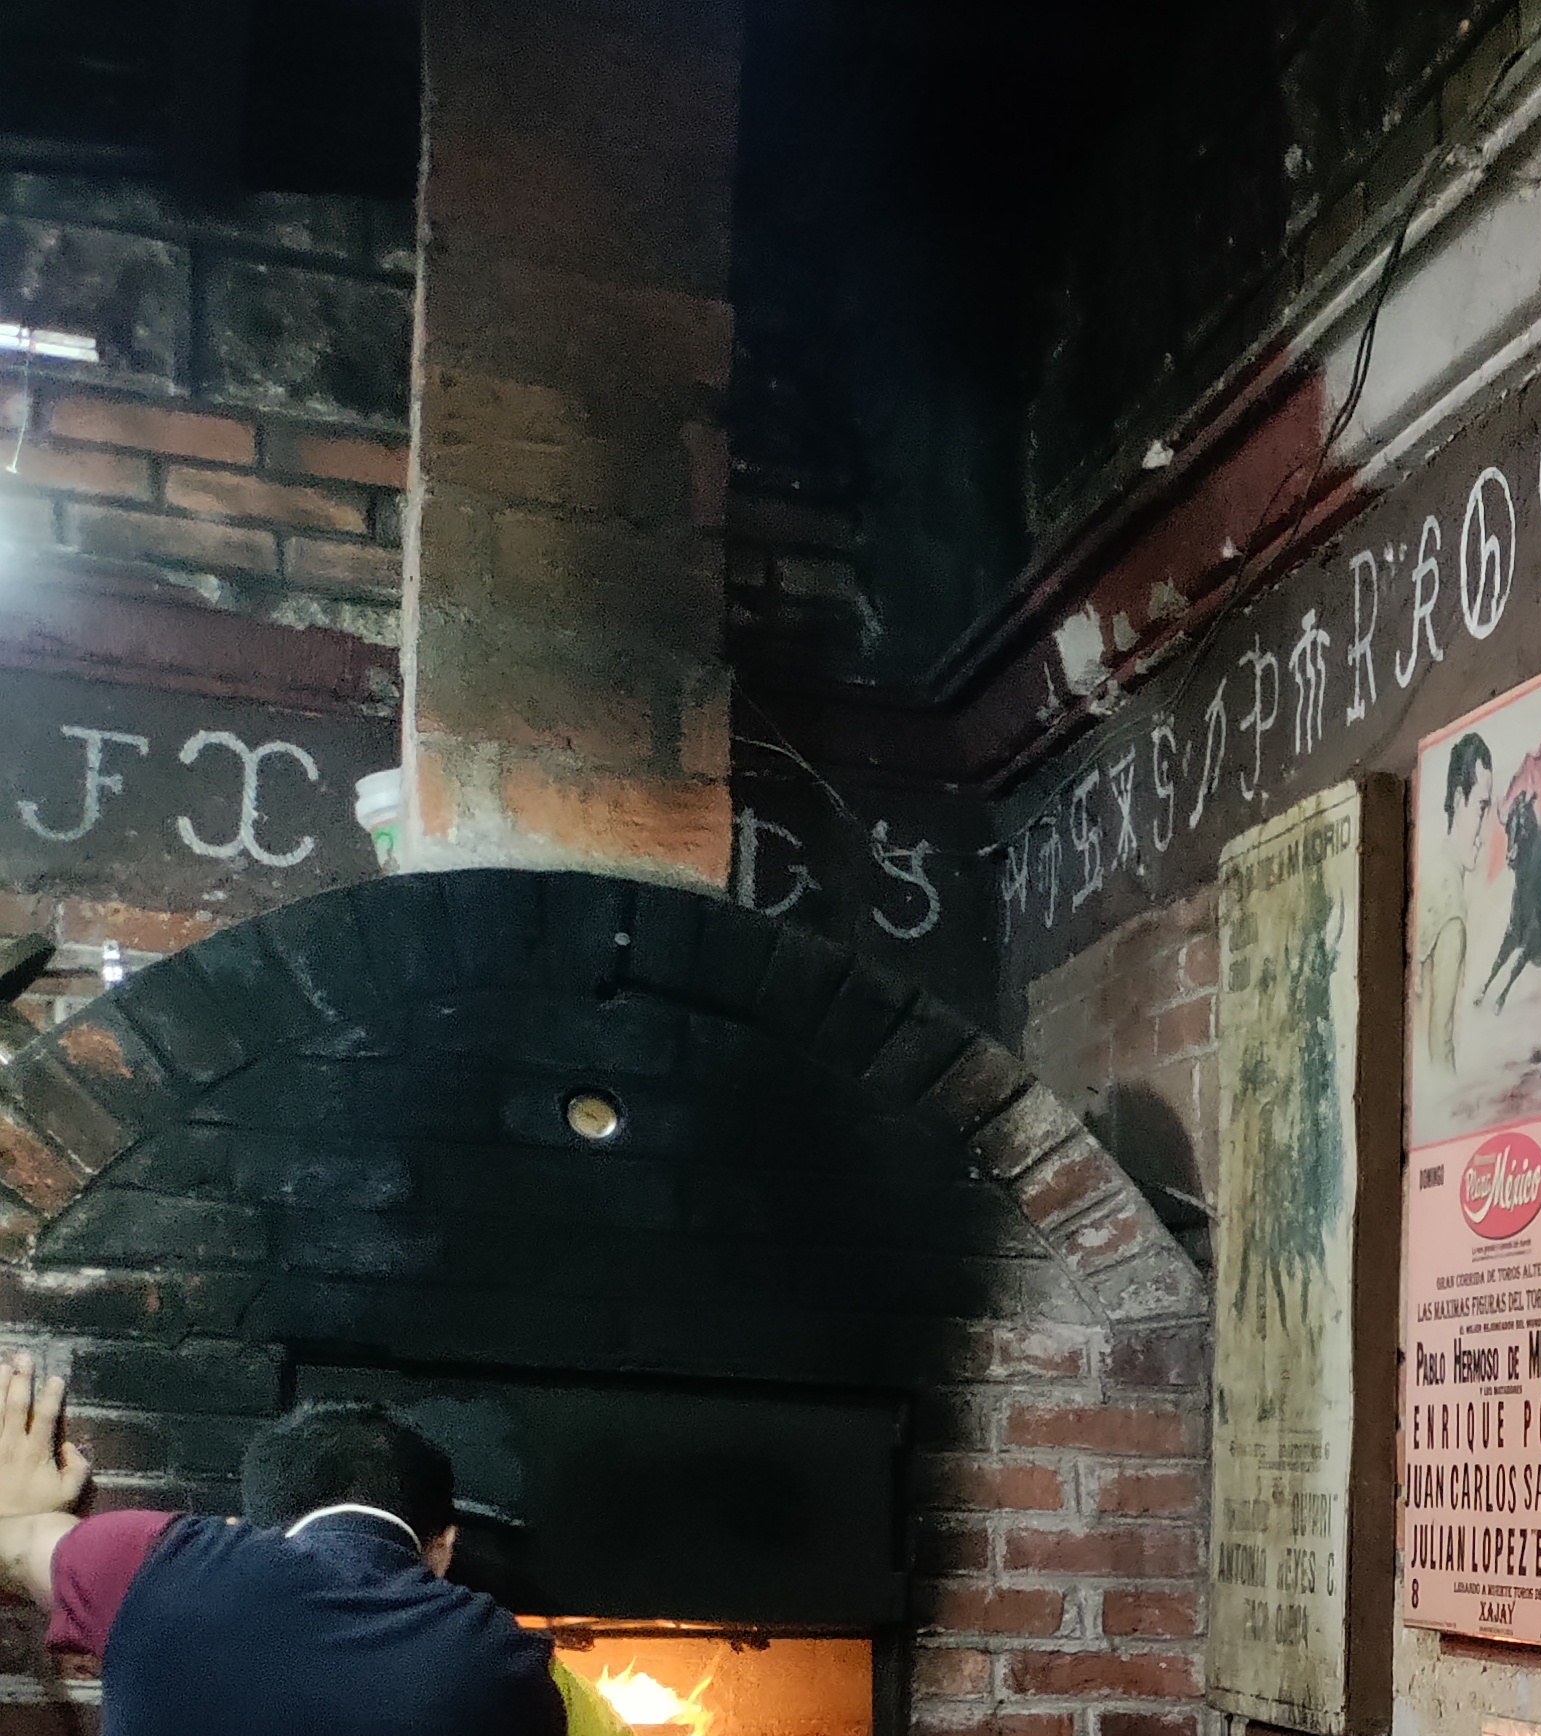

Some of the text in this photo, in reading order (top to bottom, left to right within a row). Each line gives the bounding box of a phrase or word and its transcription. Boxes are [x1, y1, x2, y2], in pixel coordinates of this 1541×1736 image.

[1415, 1340, 1447, 1387] PABLO
[1452, 1337, 1500, 1385] HERMOSO
[1507, 1345, 1520, 1382] DE
[1412, 1400, 1505, 1455] ENRIQUE
[1404, 1462, 1445, 1510] JUAN
[1449, 1461, 1518, 1514] CARLOS
[1410, 1523, 1466, 1573] JULIAN
[1471, 1525, 1528, 1577] LOPEZ
[1411, 1577, 1420, 1610] 8
[1478, 1599, 1517, 1626] XAJAY
